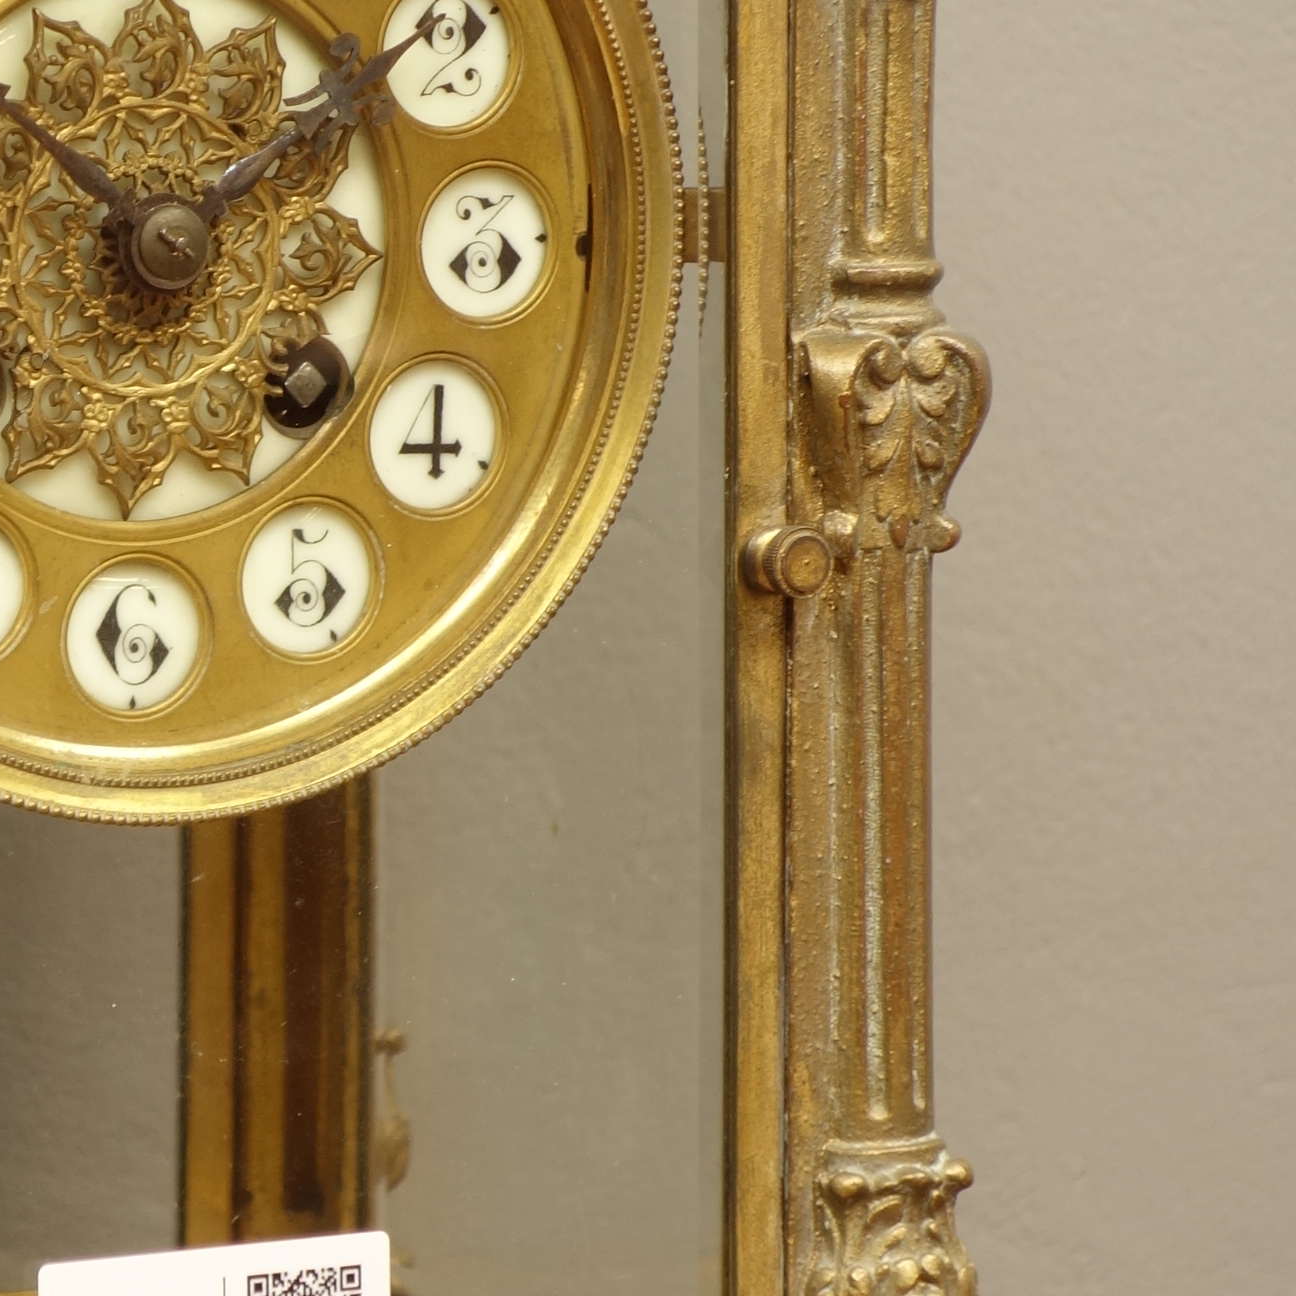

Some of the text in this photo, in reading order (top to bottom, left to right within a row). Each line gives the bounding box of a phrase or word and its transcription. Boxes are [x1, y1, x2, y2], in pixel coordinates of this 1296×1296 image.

[448, 193, 522, 293] 3
[398, 383, 463, 480] 4
[273, 527, 346, 628] 5
[95, 583, 171, 686] 6
